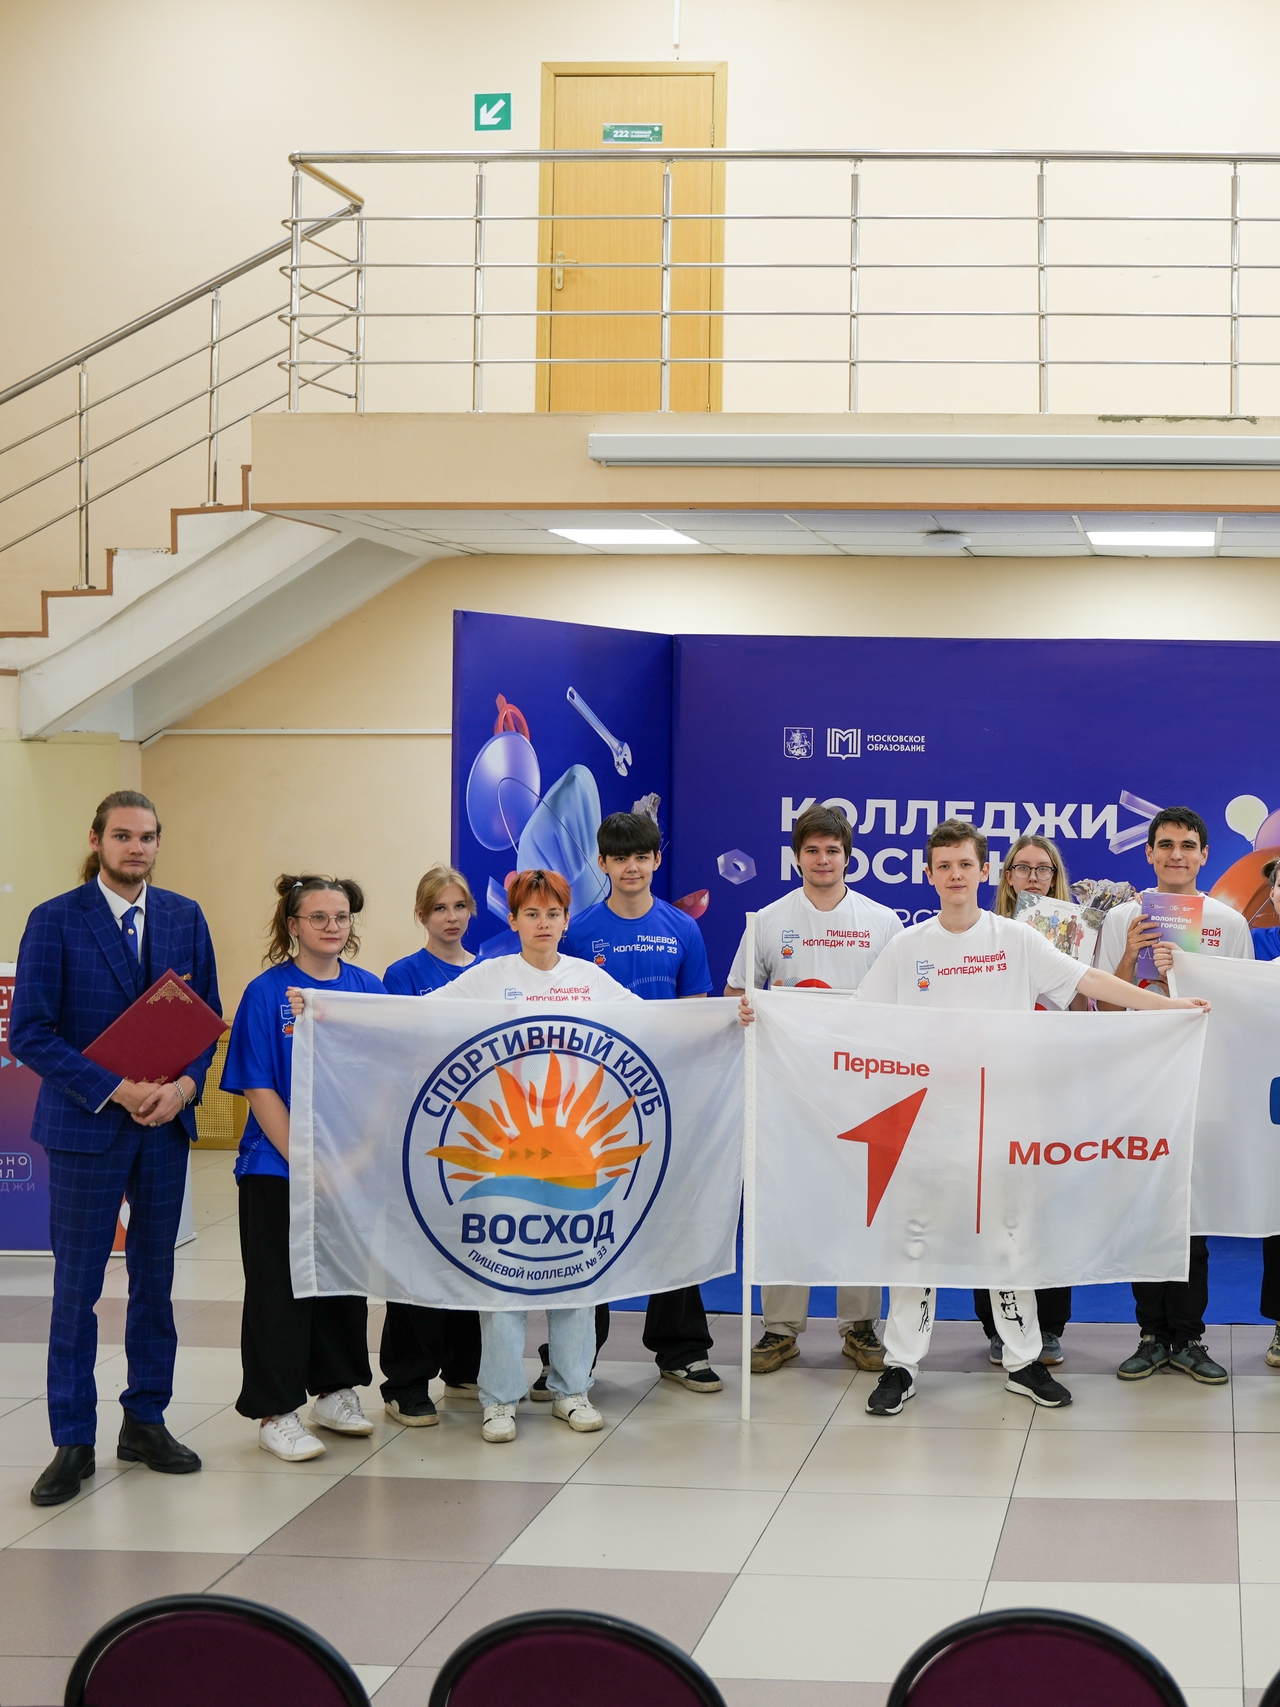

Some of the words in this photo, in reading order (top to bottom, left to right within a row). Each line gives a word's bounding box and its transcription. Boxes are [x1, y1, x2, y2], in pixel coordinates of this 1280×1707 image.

[867, 734, 926, 743] МОСКОВСКОЕ
[867, 744, 926, 752] ОБРАЗОВАНИЕ
[826, 930, 870, 938] ПИЩЕВОЙ
[637, 935, 677, 945] ПИЩЕВОЙ
[803, 939, 843, 948] КОЛЛЕДЖ
[1208, 939, 1220, 947] 33
[613, 944, 653, 953] КОЛЛЕДЖ
[964, 950, 1006, 963] ПИЩЕВОЙ
[938, 965, 982, 976] КОЛЛЕДЖ
[550, 986, 589, 994] ПИЩЕВОЙ
[833, 1051, 930, 1079] Первые
[422, 1026, 615, 1118] СПОРТИВНЫЙ
[614, 1050, 662, 1116] КЛУБ
[1009, 1136, 1170, 1165] МОСКВА
[461, 1210, 614, 1248] ВОСХОД
[468, 1249, 524, 1279] ПИЩЕВОЙ
[526, 1263, 584, 1280] КОЛЛЕДЖ
[586, 1257, 598, 1269] №
[597, 1246, 608, 1259] 33
